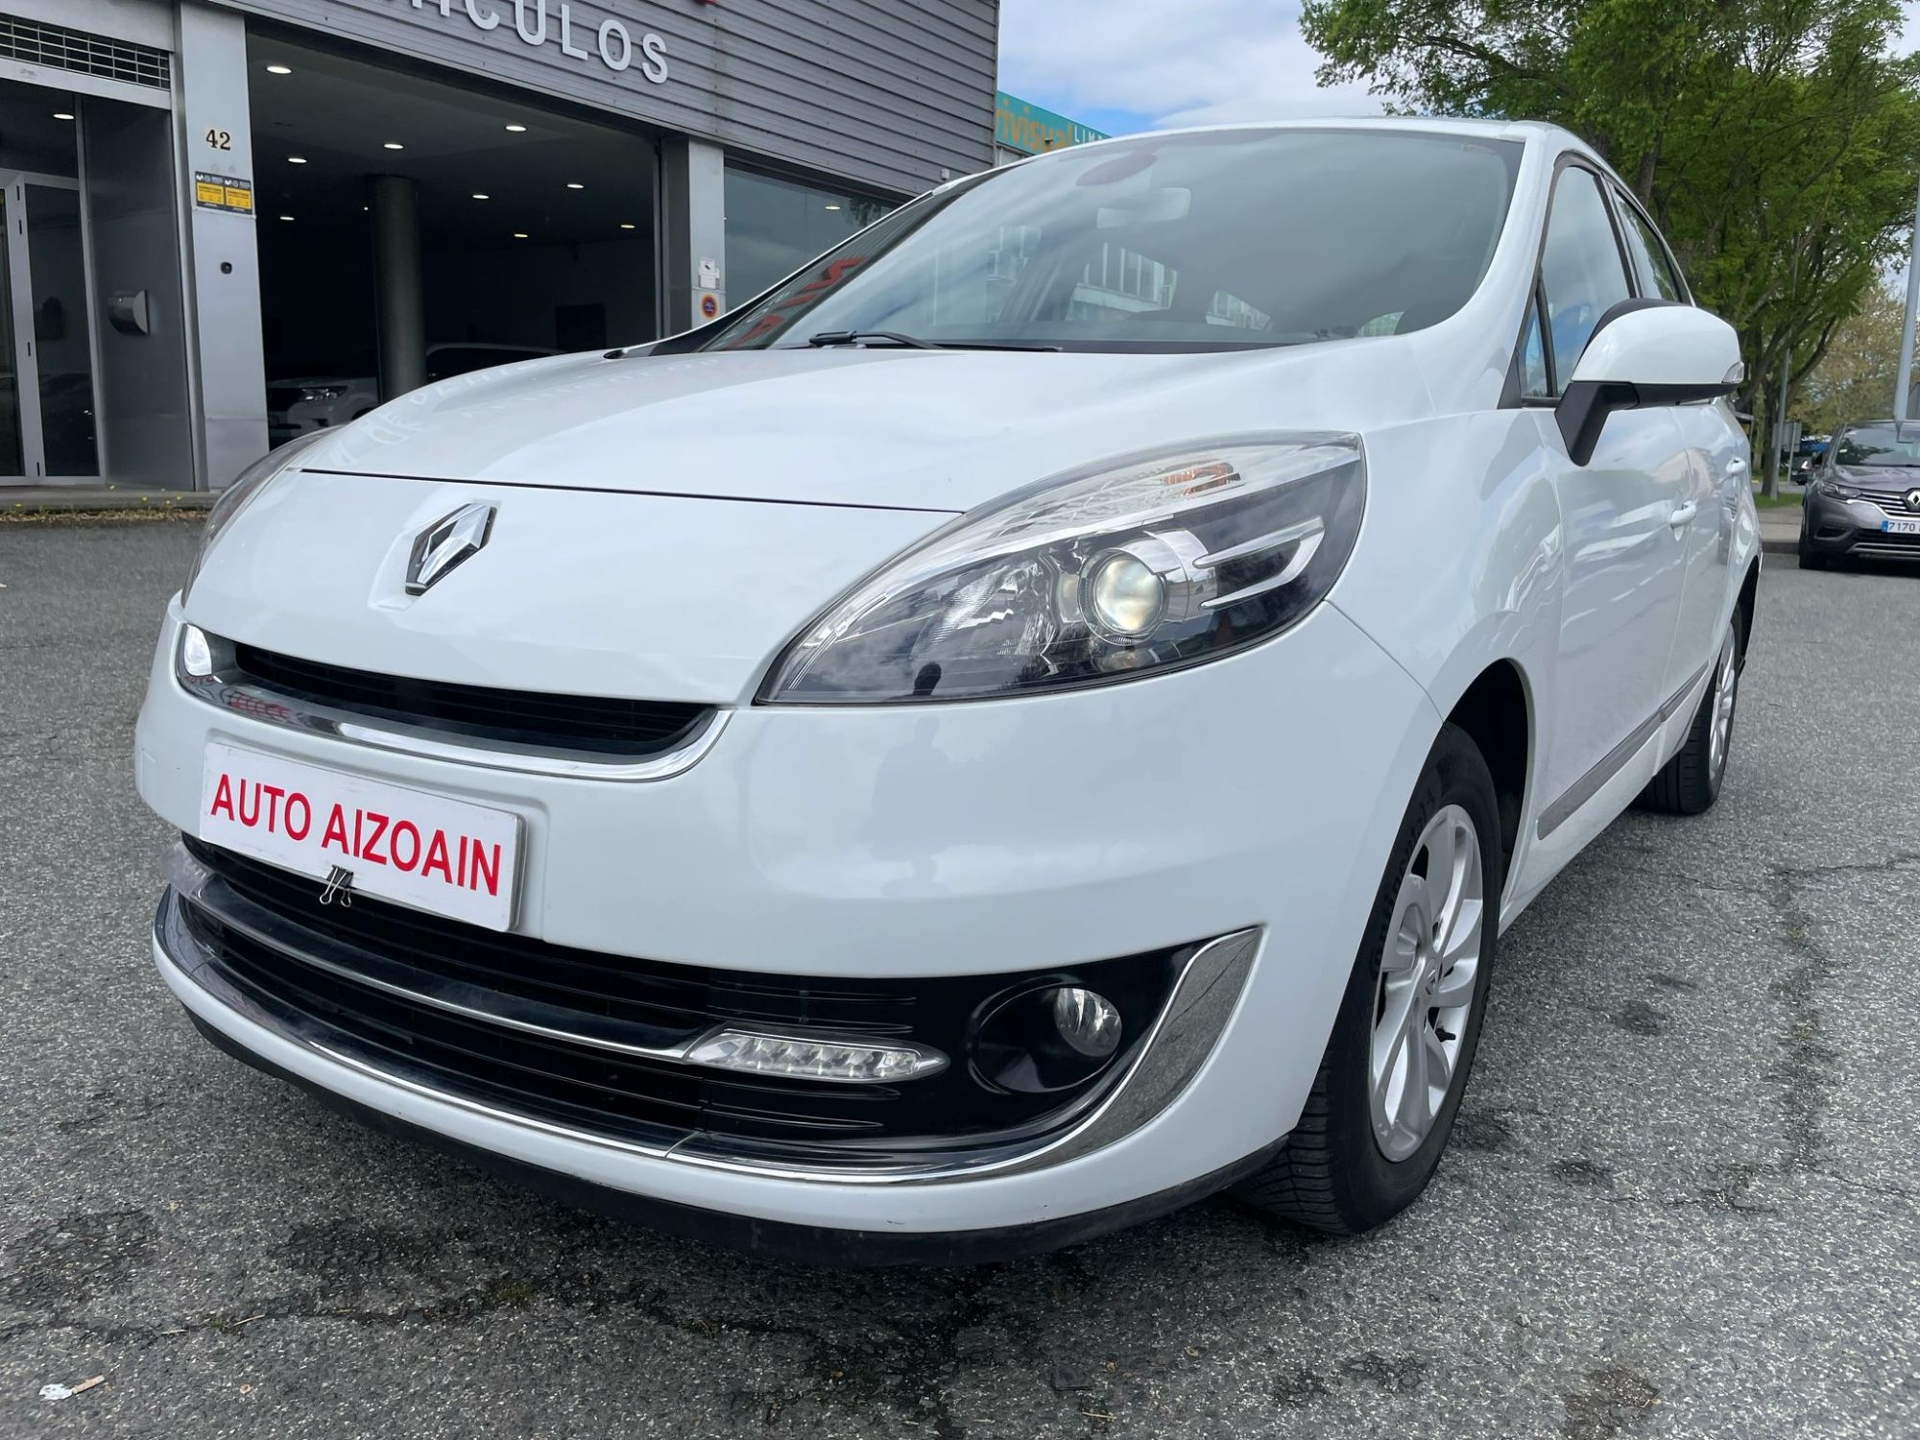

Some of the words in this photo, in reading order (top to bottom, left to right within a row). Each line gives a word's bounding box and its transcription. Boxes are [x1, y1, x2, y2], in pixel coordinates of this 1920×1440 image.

[411, 0, 668, 84] CULOS
[206, 129, 231, 151] 42
[1889, 522, 1916, 532] 7170
[210, 774, 311, 841] AUTO
[321, 803, 501, 896] AIZOAIN
